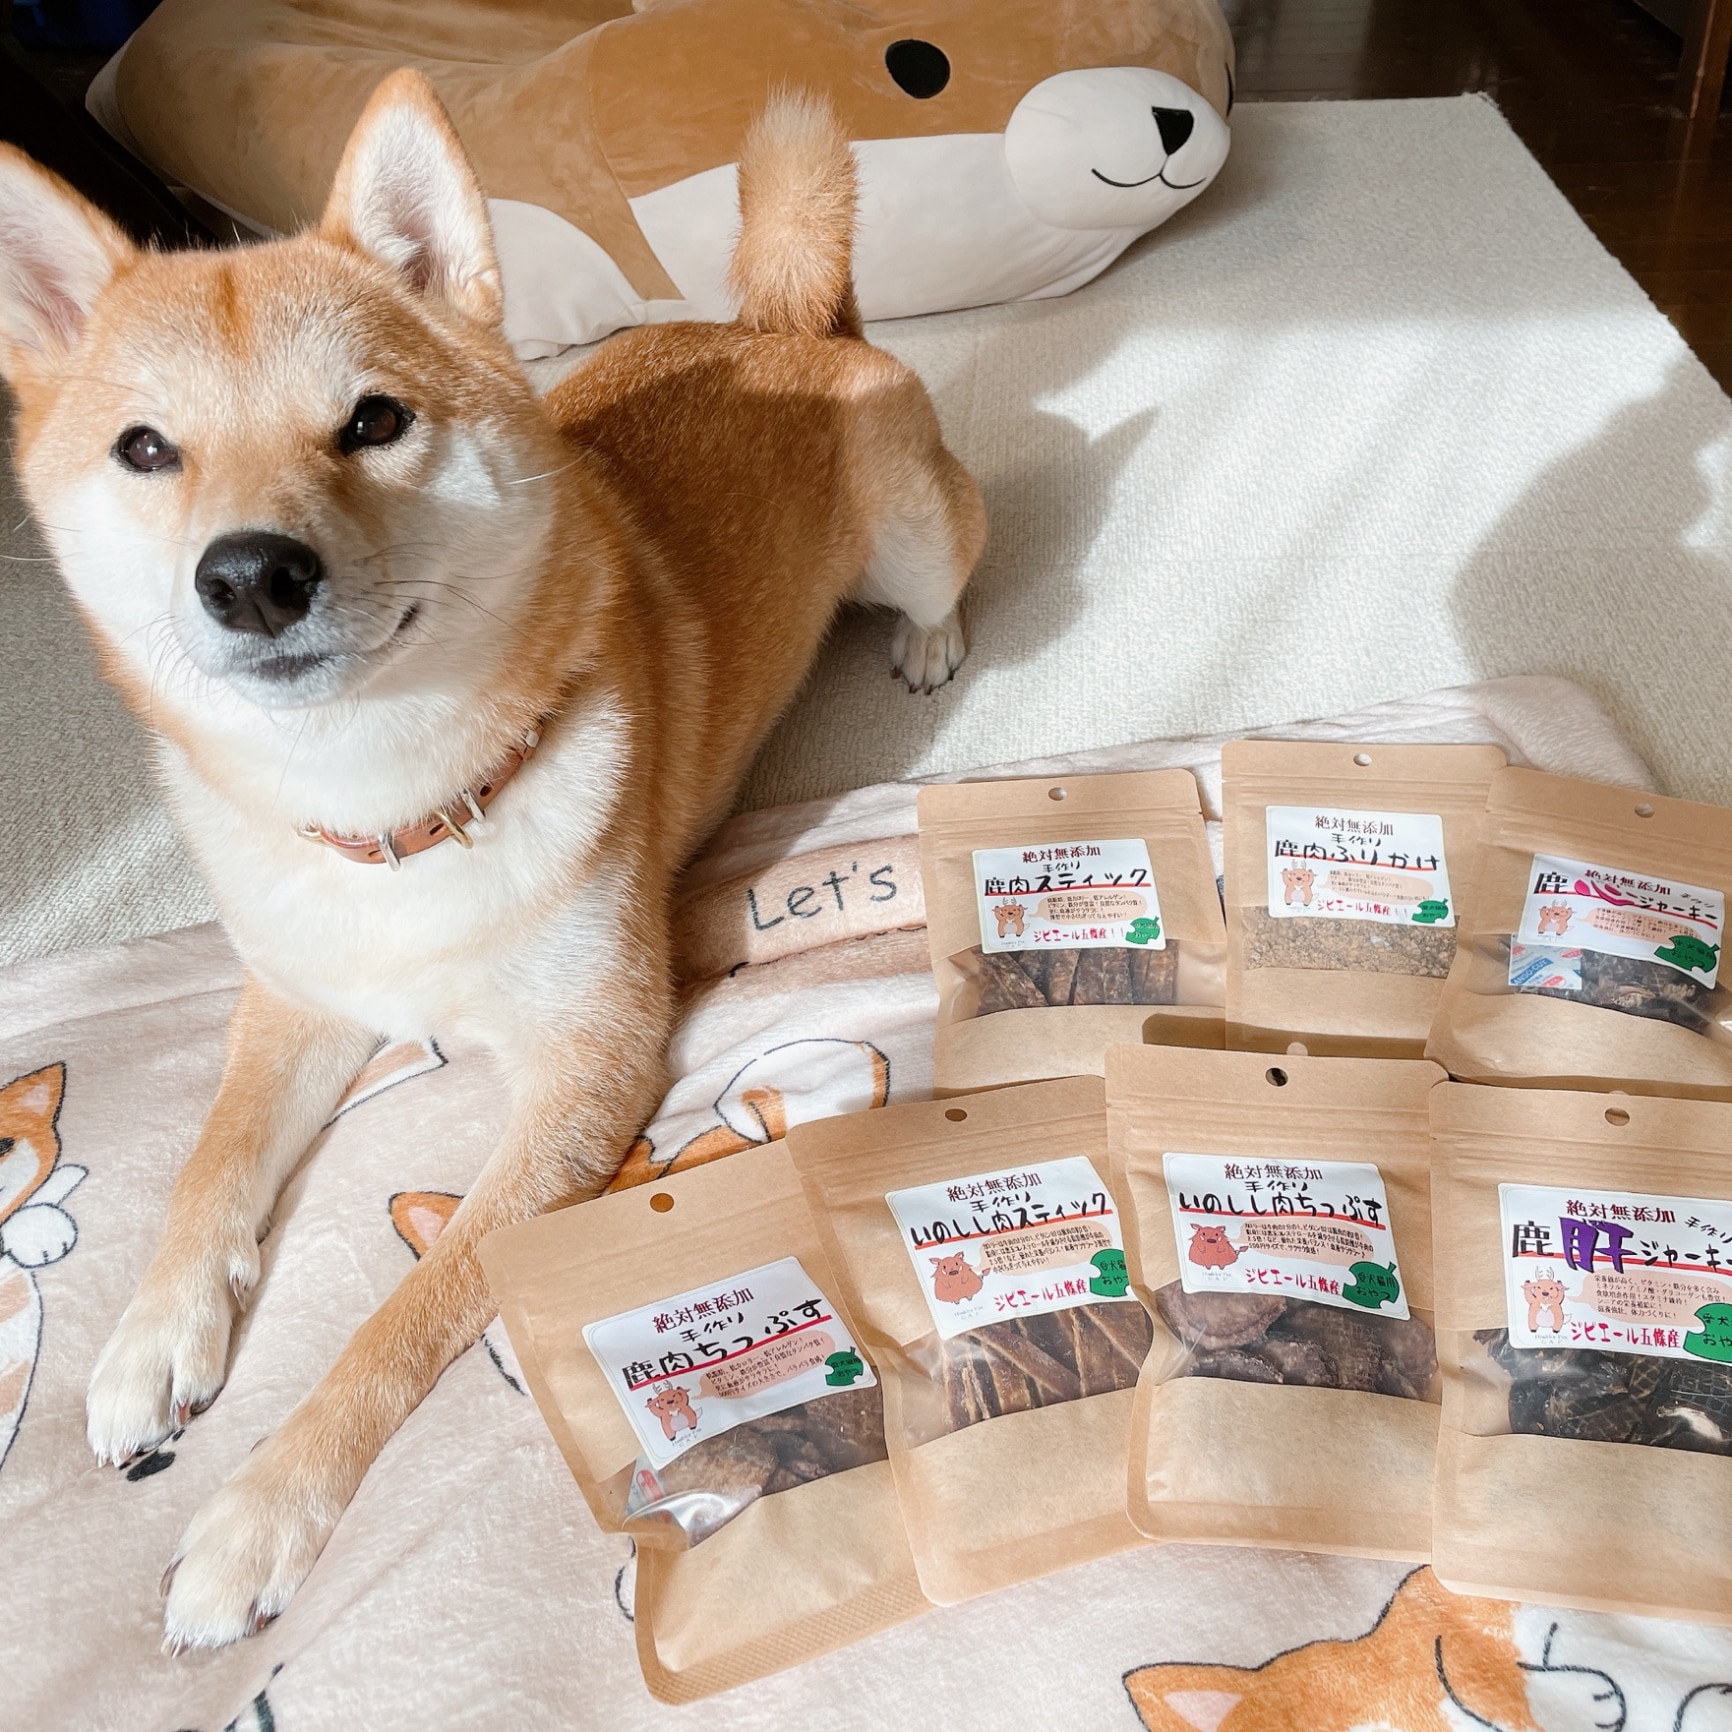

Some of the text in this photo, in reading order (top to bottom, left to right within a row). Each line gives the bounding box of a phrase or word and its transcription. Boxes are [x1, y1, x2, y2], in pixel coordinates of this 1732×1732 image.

[1315, 815, 1394, 836] 絶対無添加
[1331, 833, 1382, 846] 手作り
[1022, 845, 1101, 863] 絶対無添加
[1042, 861, 1081, 872] 手作り
[1275, 839, 1440, 870] 鹿肉ふりかけ
[747, 861, 897, 931] Let's
[985, 868, 1149, 896] 鹿肉スティック
[1584, 869, 1671, 896] 絶対無添加
[1224, 1163, 1323, 1181] 絶対無添加
[1245, 1180, 1308, 1192] 手作り
[946, 1172, 1042, 1202] 絶対無添加
[971, 1191, 1032, 1213] 手作り
[1179, 1192, 1383, 1227] いのしし肉ちっぷす
[1566, 1199, 1677, 1224] 絶対無添加
[910, 1192, 1107, 1245] いのしし肉スティック
[994, 1278, 1089, 1312] ジビエール五條産
[1246, 1268, 1341, 1296] ジビエール五條産
[1356, 1286, 1391, 1299] おやつ
[652, 1287, 754, 1334] 絶対無添加
[679, 1311, 745, 1343] 手作り
[1570, 1321, 1681, 1349] ジビエール五條産
[621, 1298, 823, 1389] 鹿肉ちっぷす
